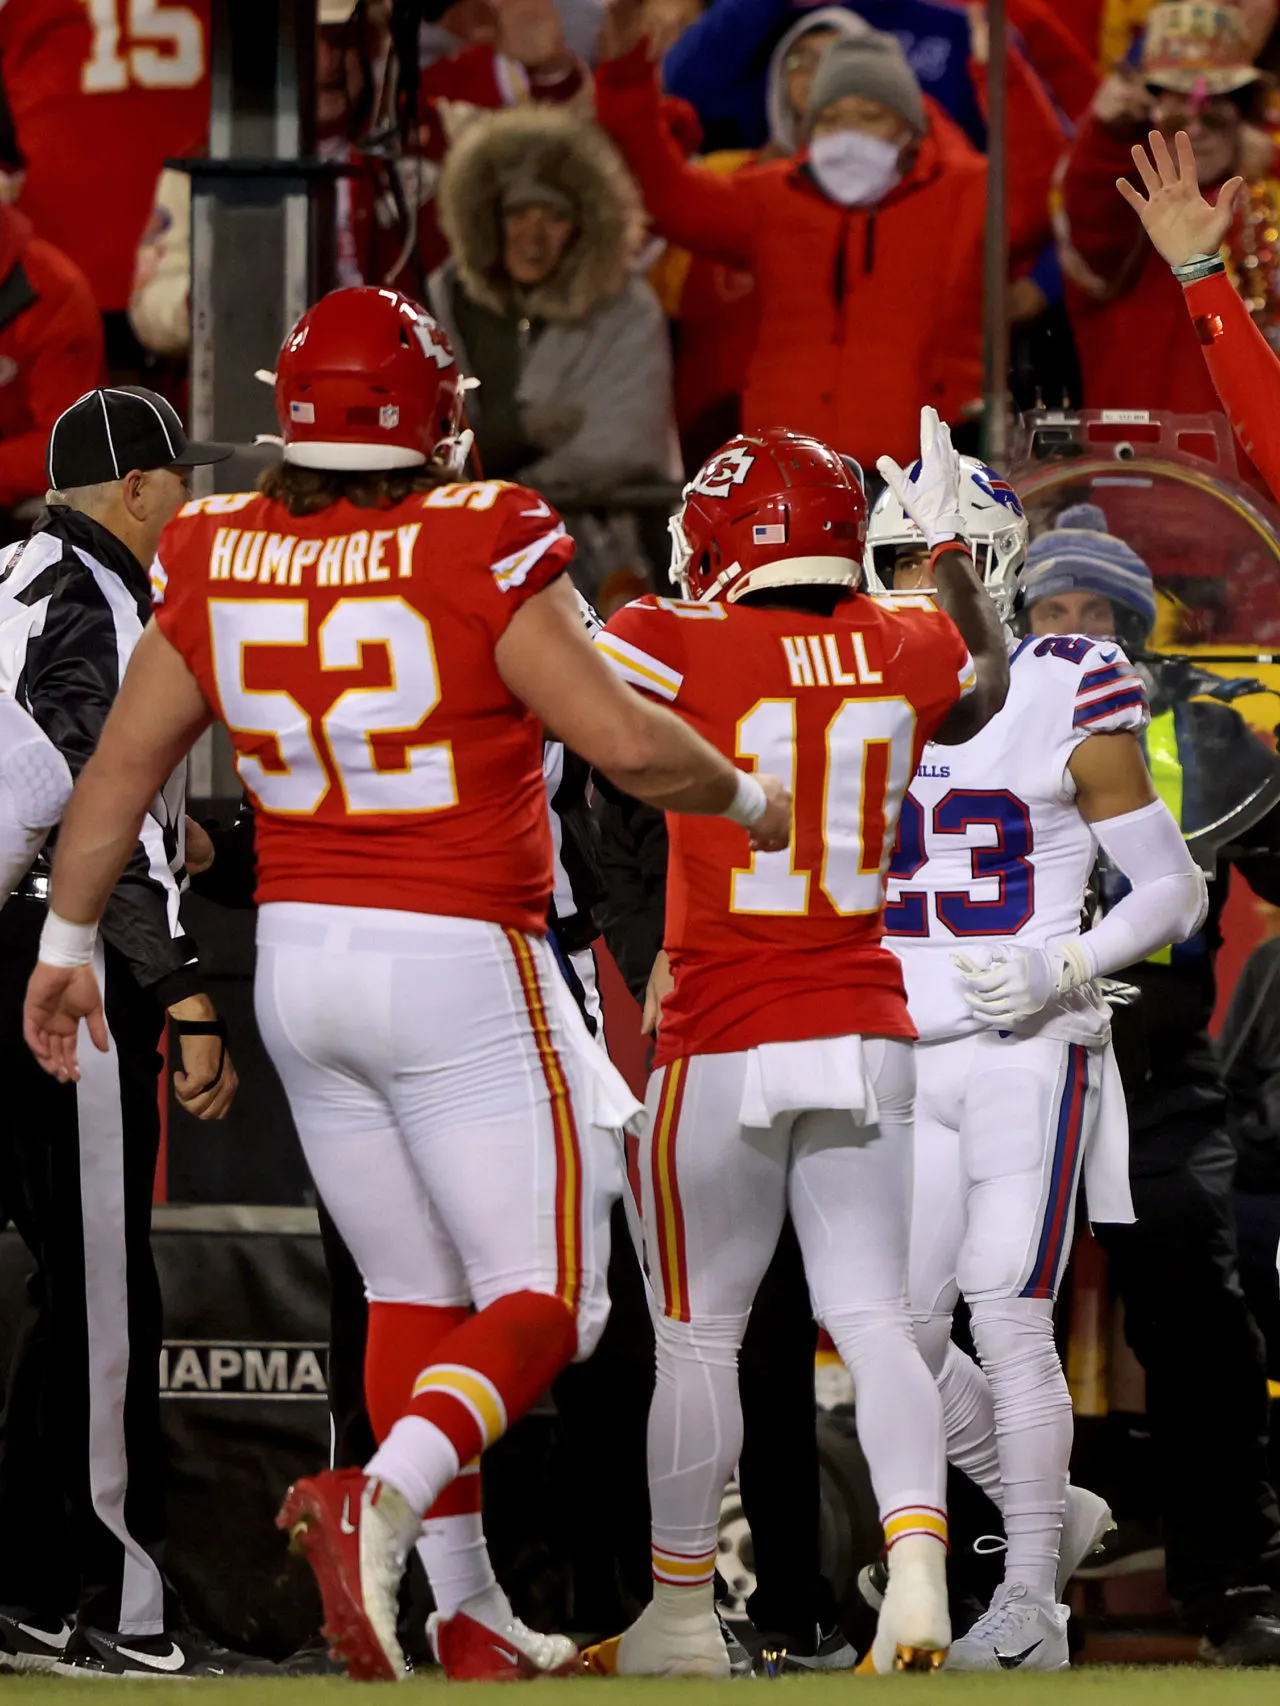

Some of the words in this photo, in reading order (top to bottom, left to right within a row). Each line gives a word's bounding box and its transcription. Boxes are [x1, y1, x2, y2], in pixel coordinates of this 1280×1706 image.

[80, 0, 205, 94] 15
[209, 522, 423, 587] HUMPHREY
[781, 632, 883, 686] HILL
[207, 595, 459, 815] 52
[917, 765, 951, 778] ILLS
[729, 695, 917, 916] 10
[159, 1348, 329, 1391] APMA
